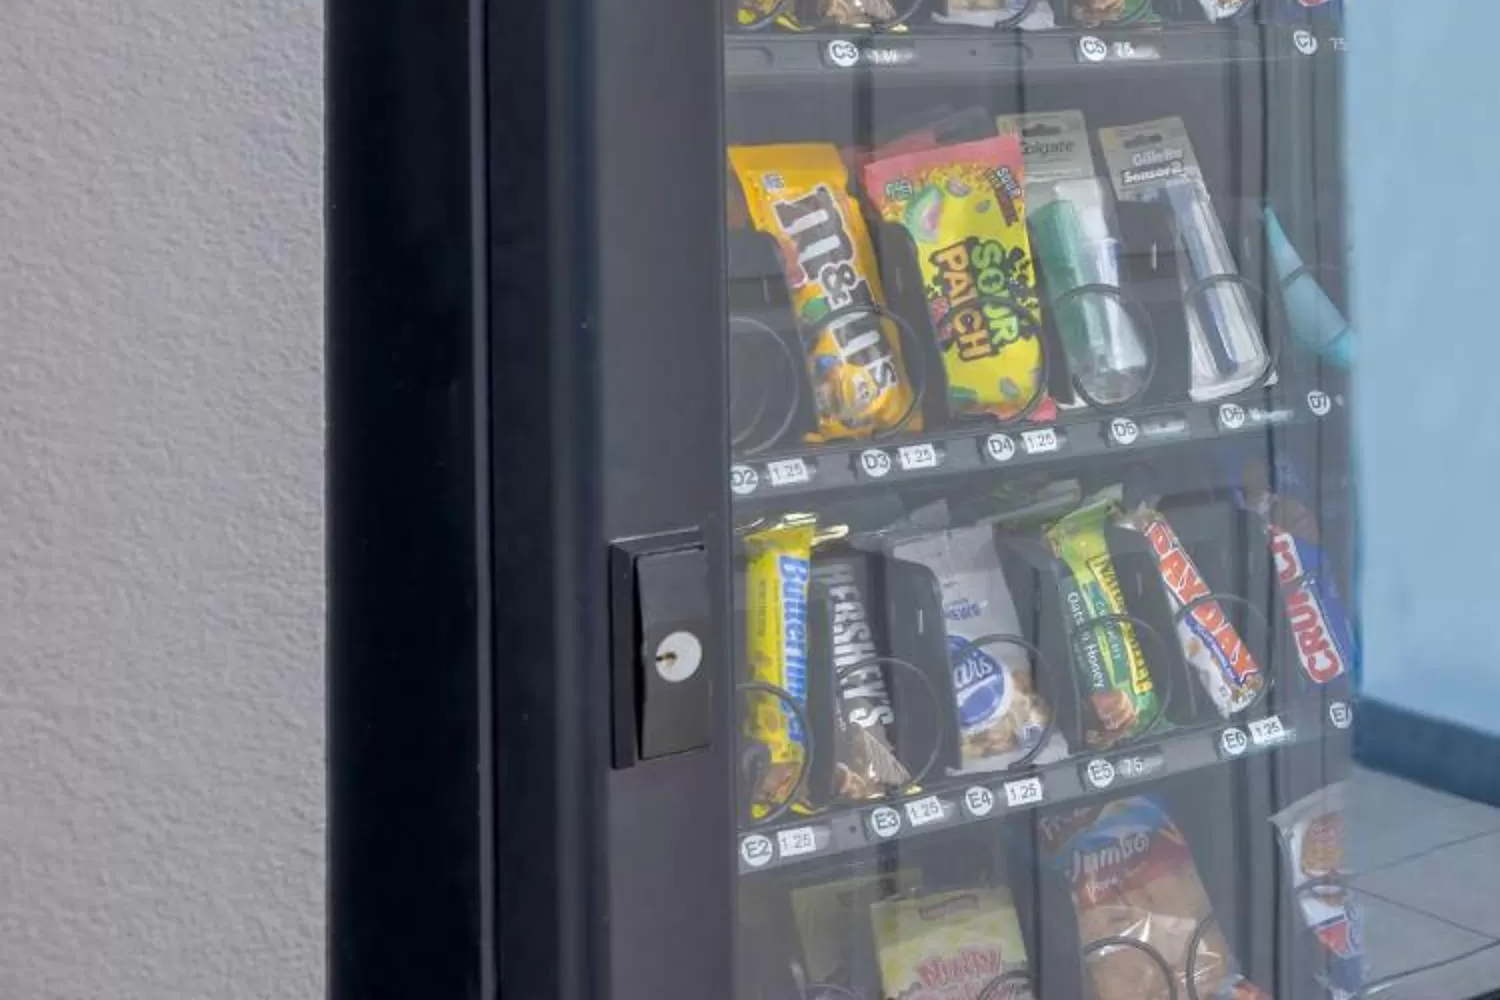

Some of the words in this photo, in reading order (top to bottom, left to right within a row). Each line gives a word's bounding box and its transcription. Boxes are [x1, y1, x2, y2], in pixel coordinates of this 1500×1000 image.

[832, 43, 857, 60] C3
[1083, 38, 1106, 55] C5
[971, 241, 1021, 346] SOUR
[1113, 421, 1138, 438] D5
[989, 437, 1014, 455] D4
[864, 451, 889, 470] D3
[731, 469, 756, 487] D2
[1268, 534, 1344, 683] CRUC
[1224, 732, 1247, 750] E6
[1254, 720, 1282, 738] 1.25
[1089, 765, 1113, 781] E5
[969, 790, 992, 808] E4
[1009, 782, 1037, 801] 1.25
[873, 813, 899, 830] E3
[910, 803, 939, 822] 1.25
[745, 841, 772, 860] E2
[781, 830, 812, 850] 1.25
[1070, 831, 1151, 883] Jumbo
